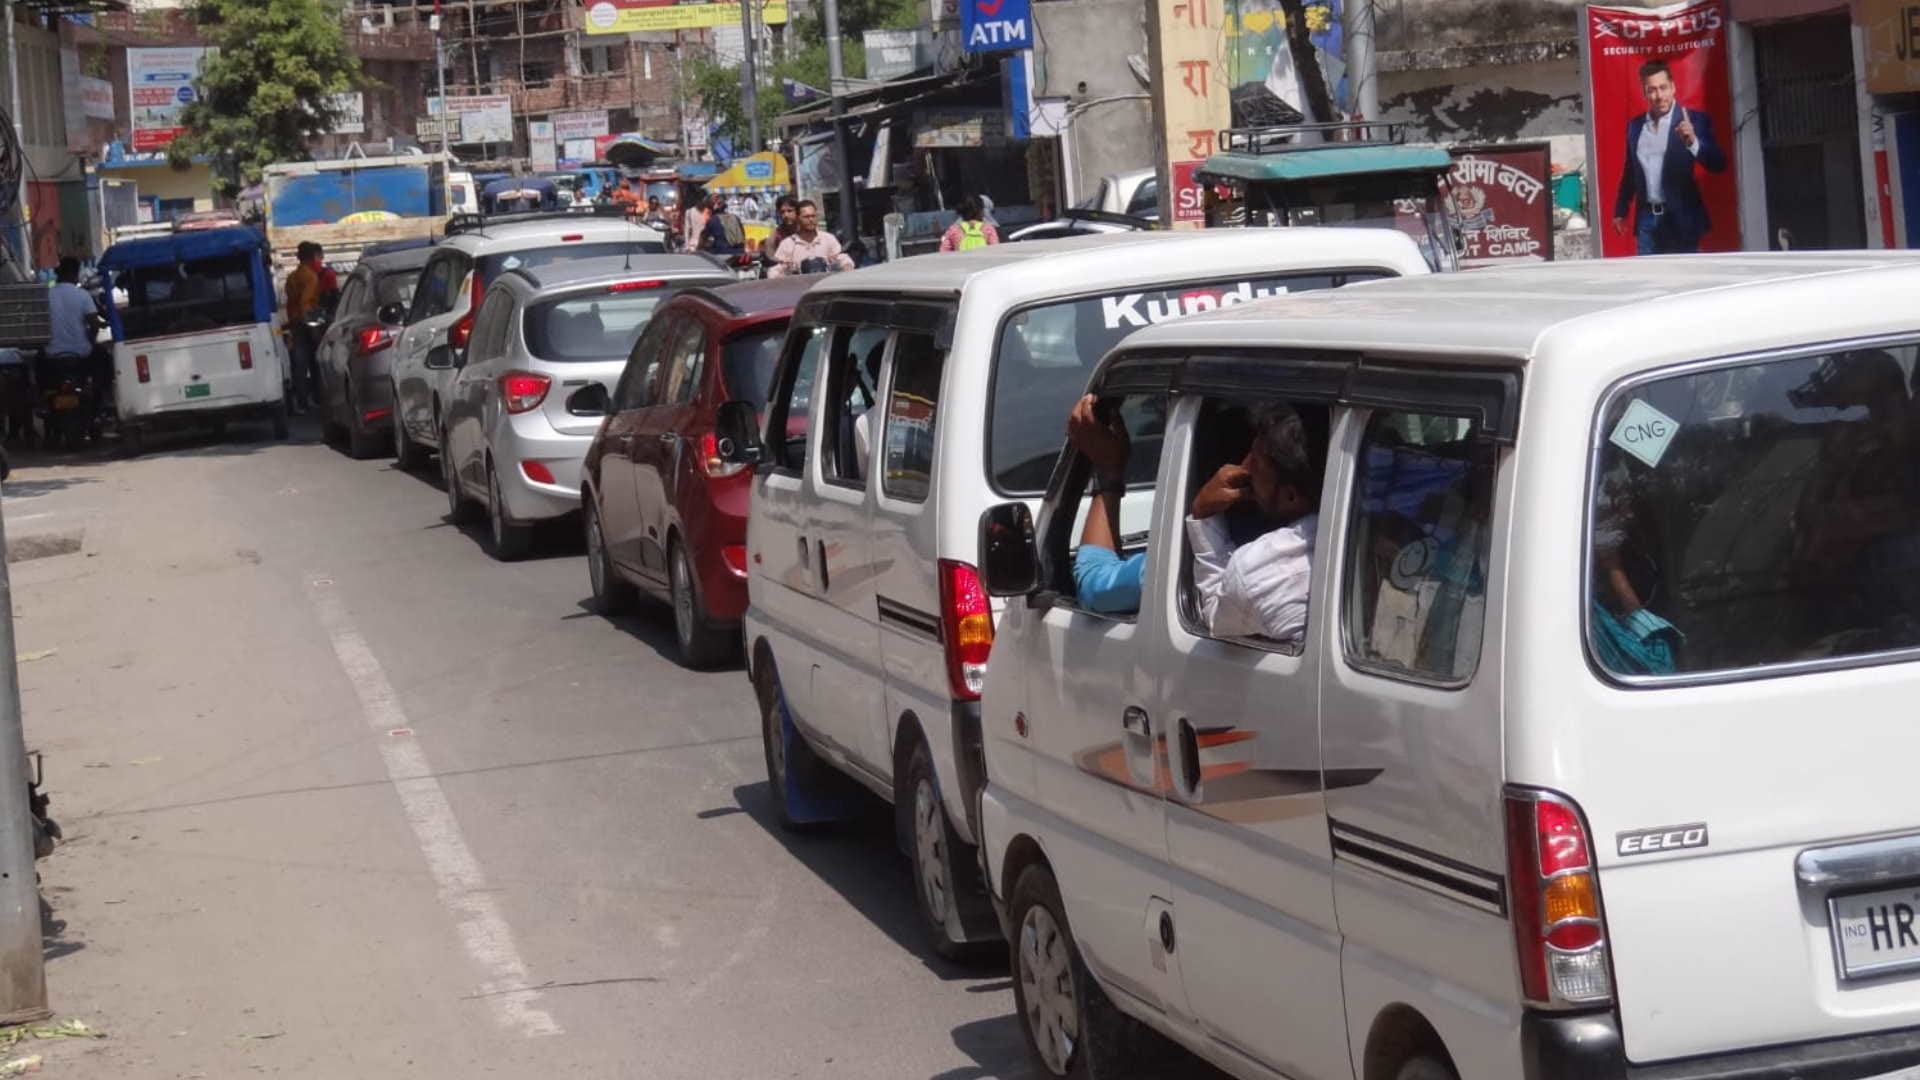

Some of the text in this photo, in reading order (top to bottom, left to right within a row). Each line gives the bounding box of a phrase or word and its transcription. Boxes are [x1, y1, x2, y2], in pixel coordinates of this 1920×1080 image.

[970, 19, 1026, 46] ATM
[1622, 7, 1720, 38] CP PLUS
[1603, 38, 1715, 56] SECURITY SOLUTIONS
[1453, 155, 1544, 205] सीमा बल
[1488, 241, 1540, 256] CAMP
[1624, 420, 1666, 443] CNG
[1619, 828, 1704, 853] EECO
[1844, 902, 1919, 951] IND HR
